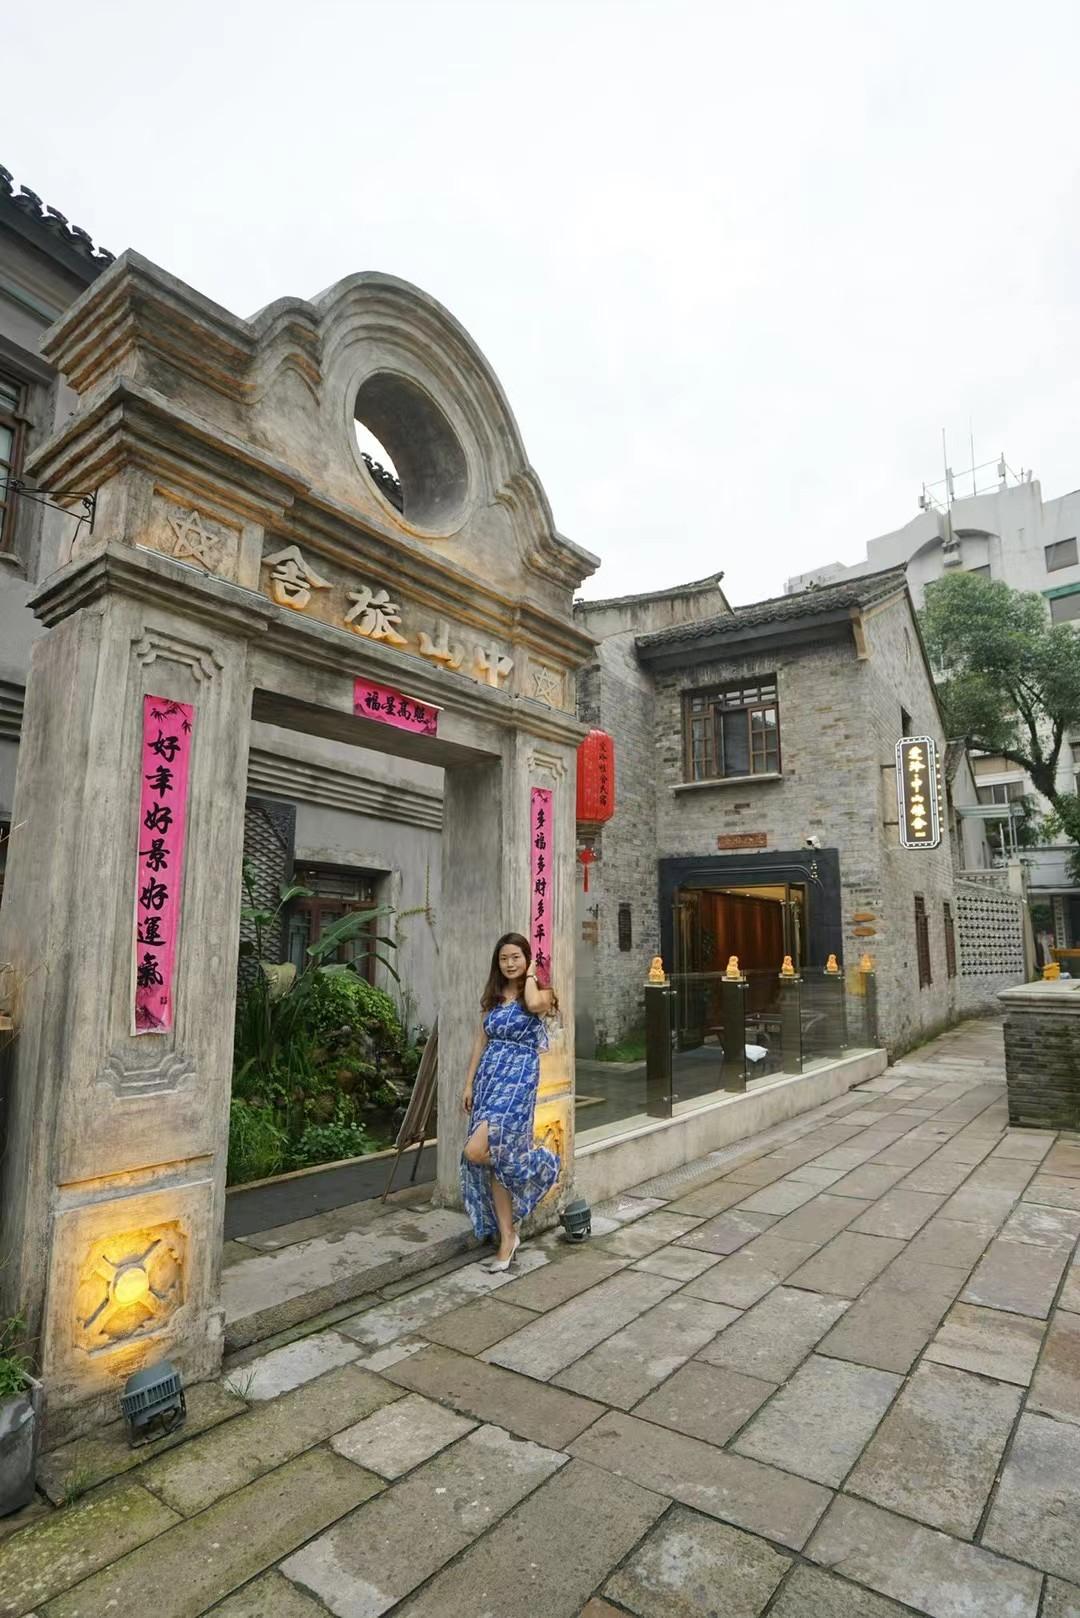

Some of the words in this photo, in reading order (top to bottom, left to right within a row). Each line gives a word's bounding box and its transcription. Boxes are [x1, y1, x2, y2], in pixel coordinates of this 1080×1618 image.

[137, 729, 181, 988] 好年好景好運氣
[534, 808, 547, 971] 多福多財多平安
